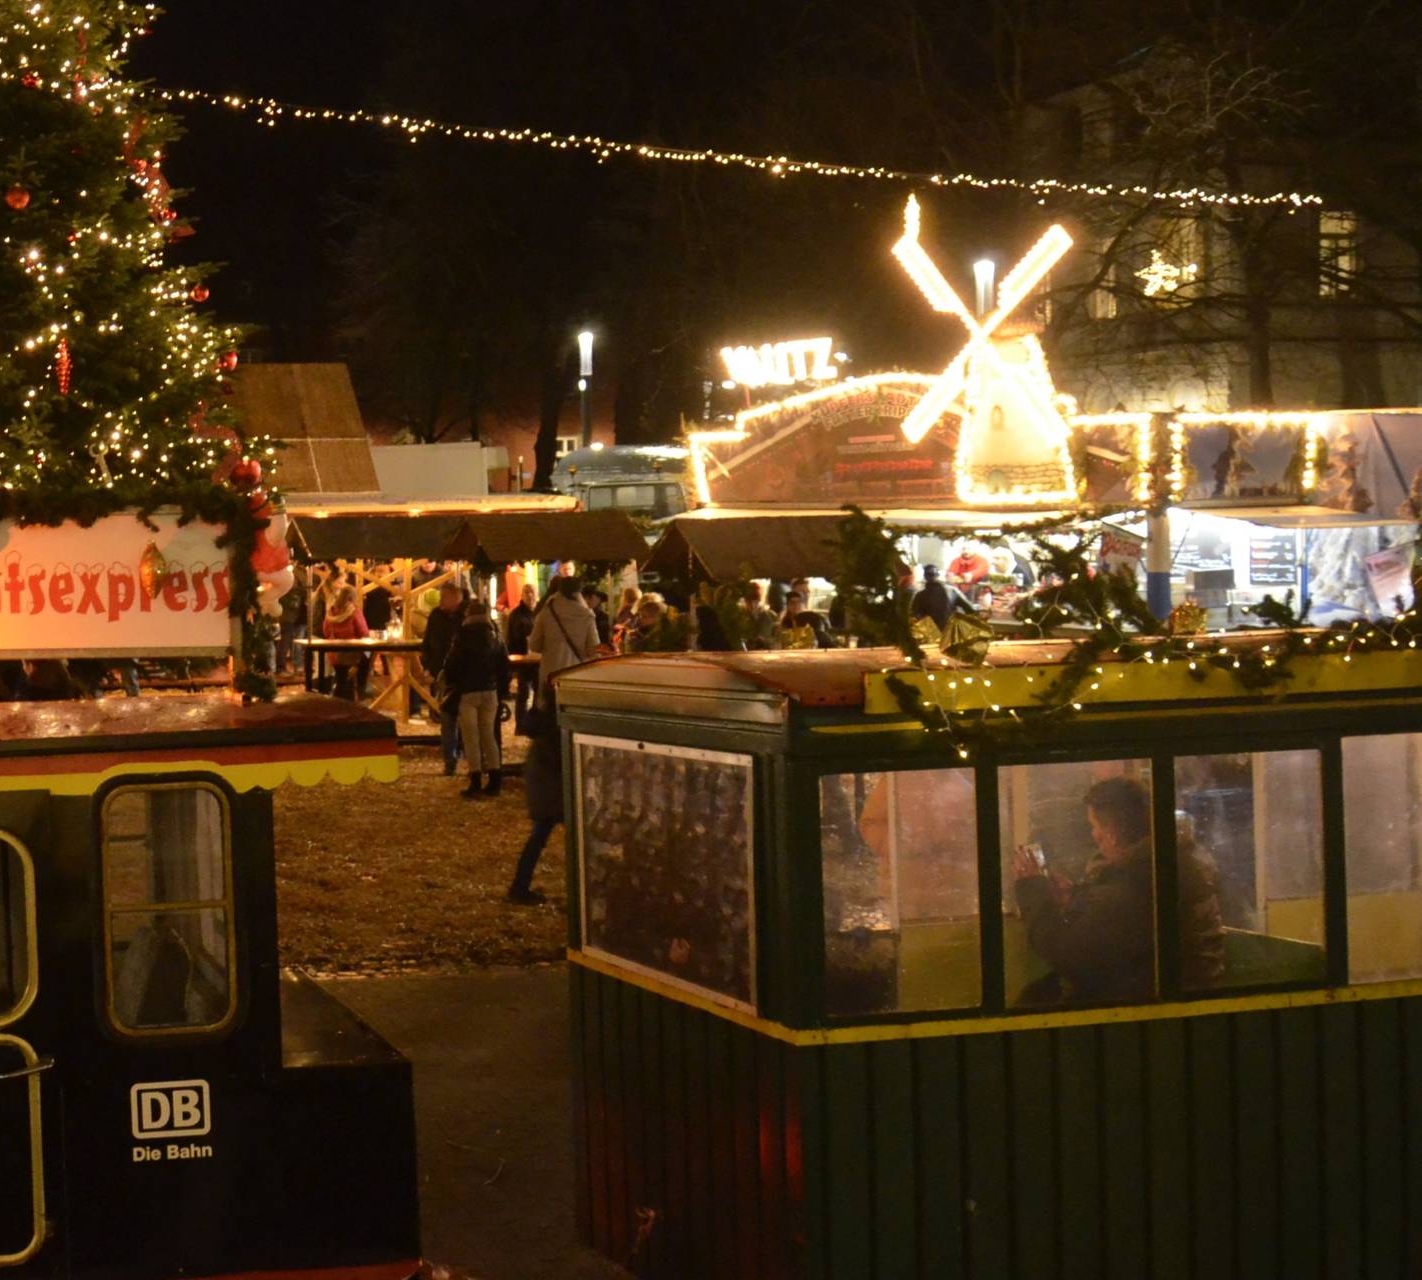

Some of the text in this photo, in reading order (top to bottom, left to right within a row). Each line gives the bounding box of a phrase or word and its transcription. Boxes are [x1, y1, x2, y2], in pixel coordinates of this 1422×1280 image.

[140, 1088, 202, 1131] DB
[132, 1143, 213, 1162] Die Bahn
